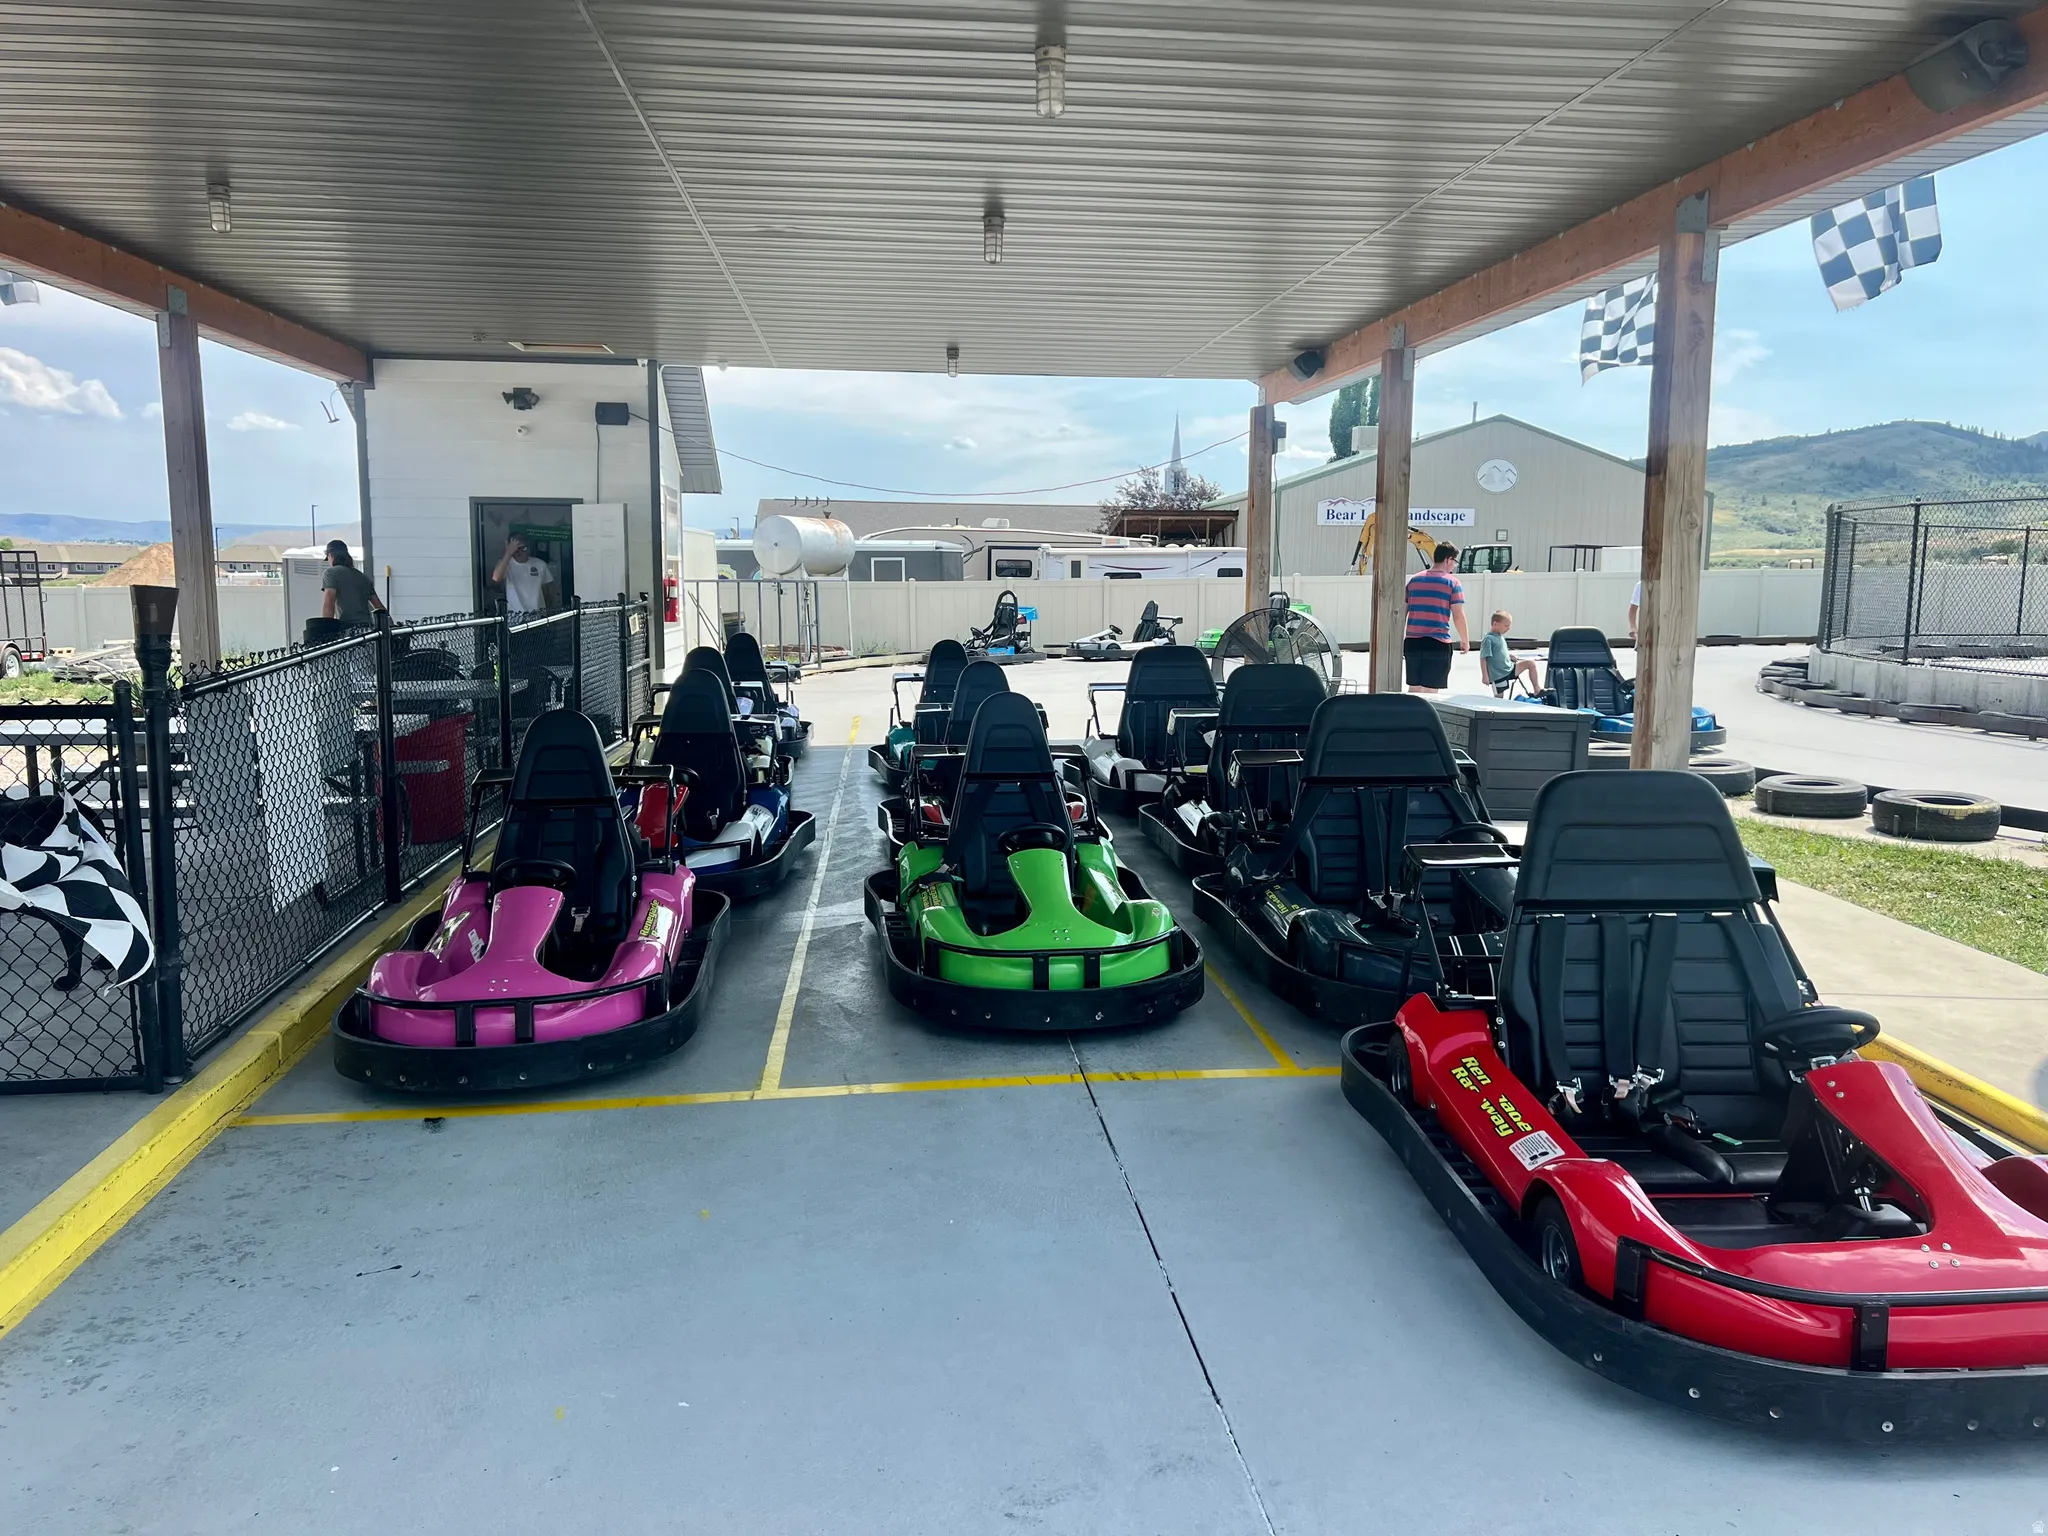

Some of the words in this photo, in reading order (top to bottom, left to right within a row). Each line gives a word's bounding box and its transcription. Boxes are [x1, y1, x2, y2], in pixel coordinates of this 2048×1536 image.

[1326, 509, 1357, 520] Bear
[1408, 509, 1466, 524] andscape
[1265, 888, 1289, 914] ceway
[639, 899, 660, 936] Renegade
